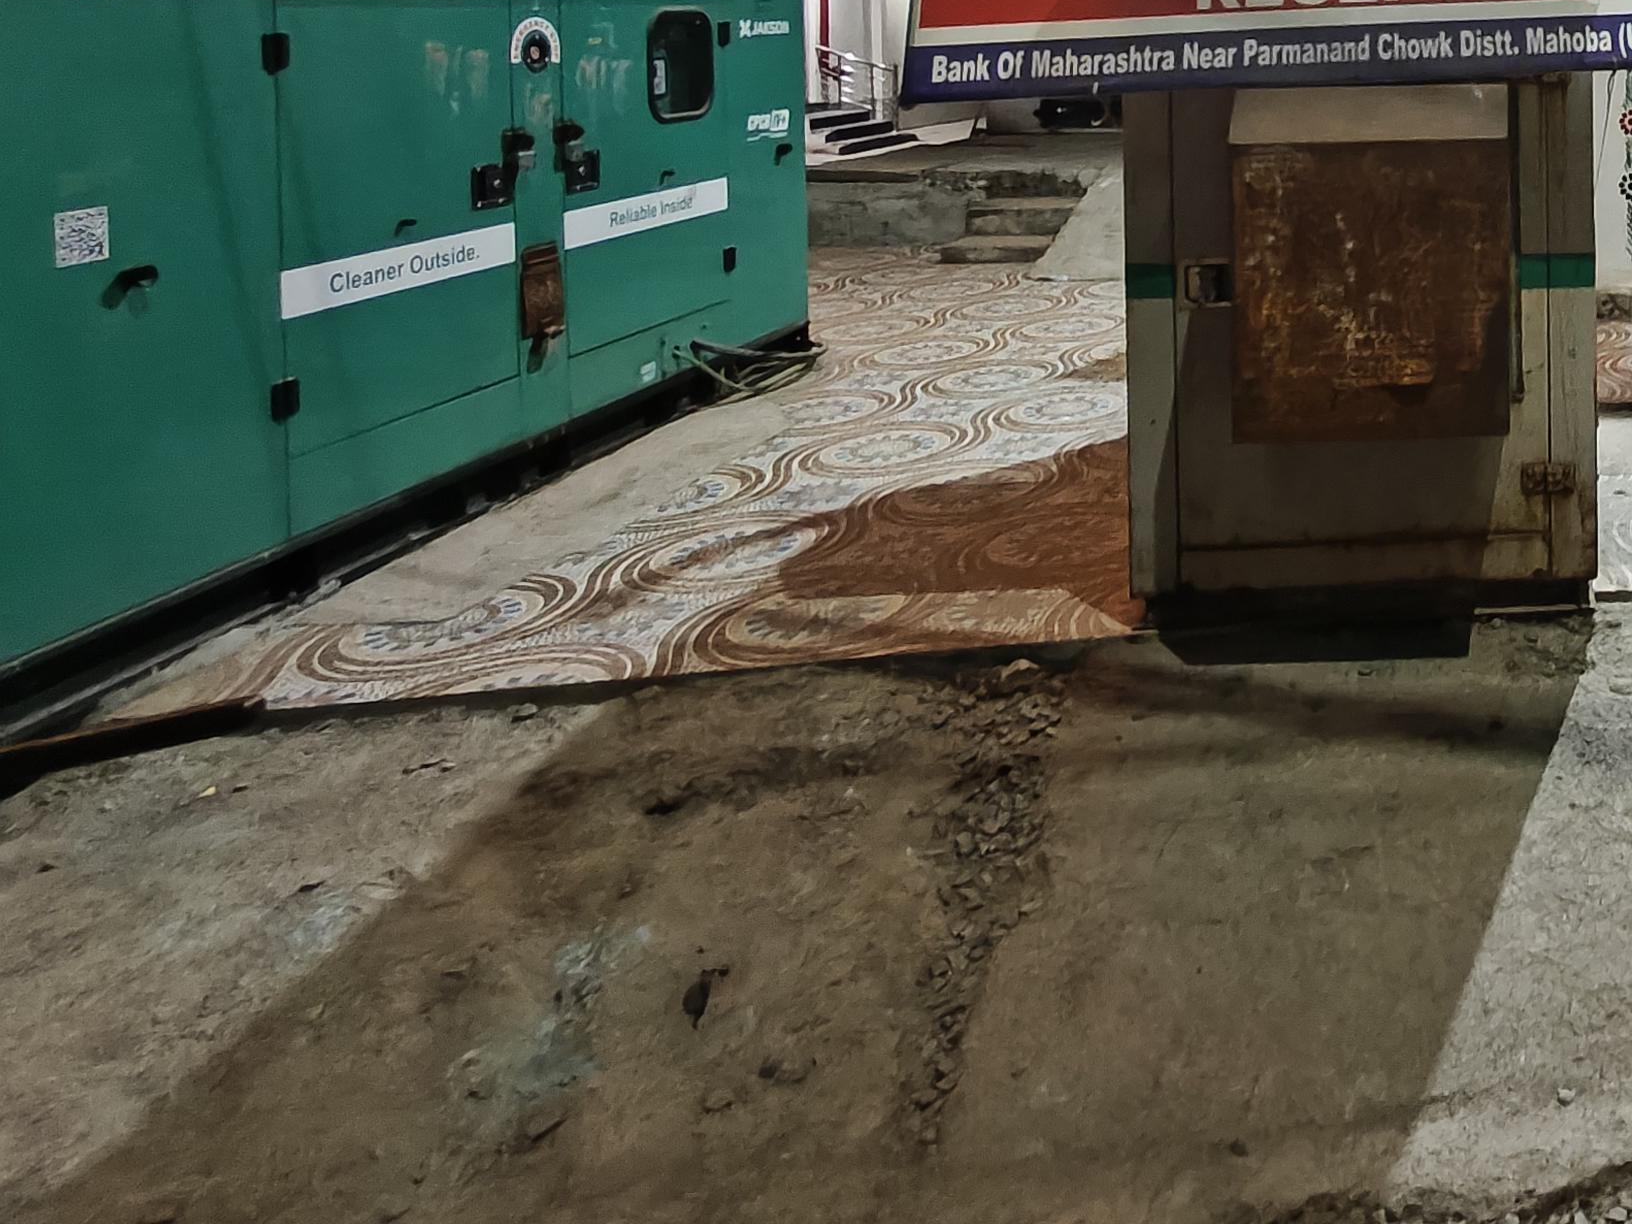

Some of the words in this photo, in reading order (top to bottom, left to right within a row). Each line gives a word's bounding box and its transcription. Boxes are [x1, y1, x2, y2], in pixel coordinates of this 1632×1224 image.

[931, 53, 990, 84] Bank
[998, 50, 1024, 79] Of
[1031, 43, 1175, 78] Maharashtra
[1183, 40, 1237, 69] Near
[1243, 33, 1369, 66] Parmanand
[1378, 30, 1454, 60] Chowk
[1460, 27, 1519, 57] Distt.
[1527, 22, 1611, 55] Mahoba
[610, 204, 657, 227] Reliable
[330, 260, 404, 294] Cleaner
[409, 245, 480, 275] Outside.
